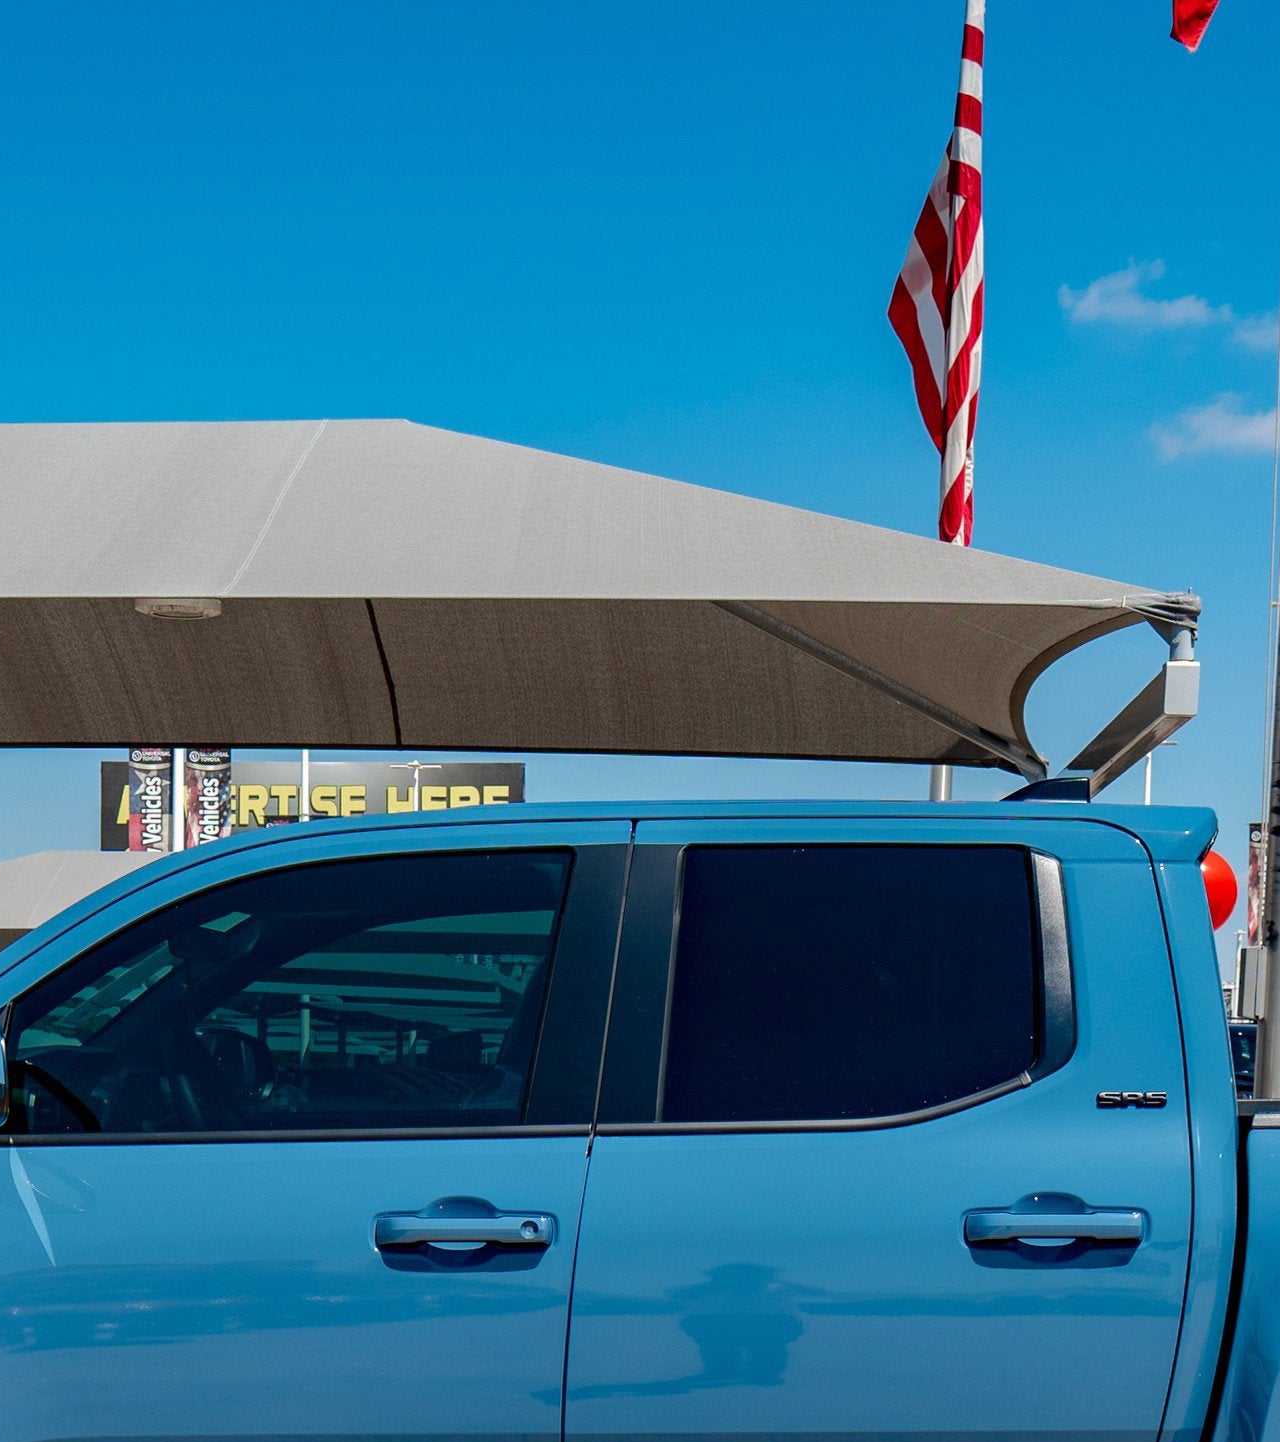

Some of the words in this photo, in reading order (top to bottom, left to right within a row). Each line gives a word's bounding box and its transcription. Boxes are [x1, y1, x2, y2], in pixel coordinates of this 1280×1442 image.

[141, 776, 162, 845] Vehicles
[198, 777, 220, 844] Vehicles
[1097, 1091, 1168, 1107] SR5
